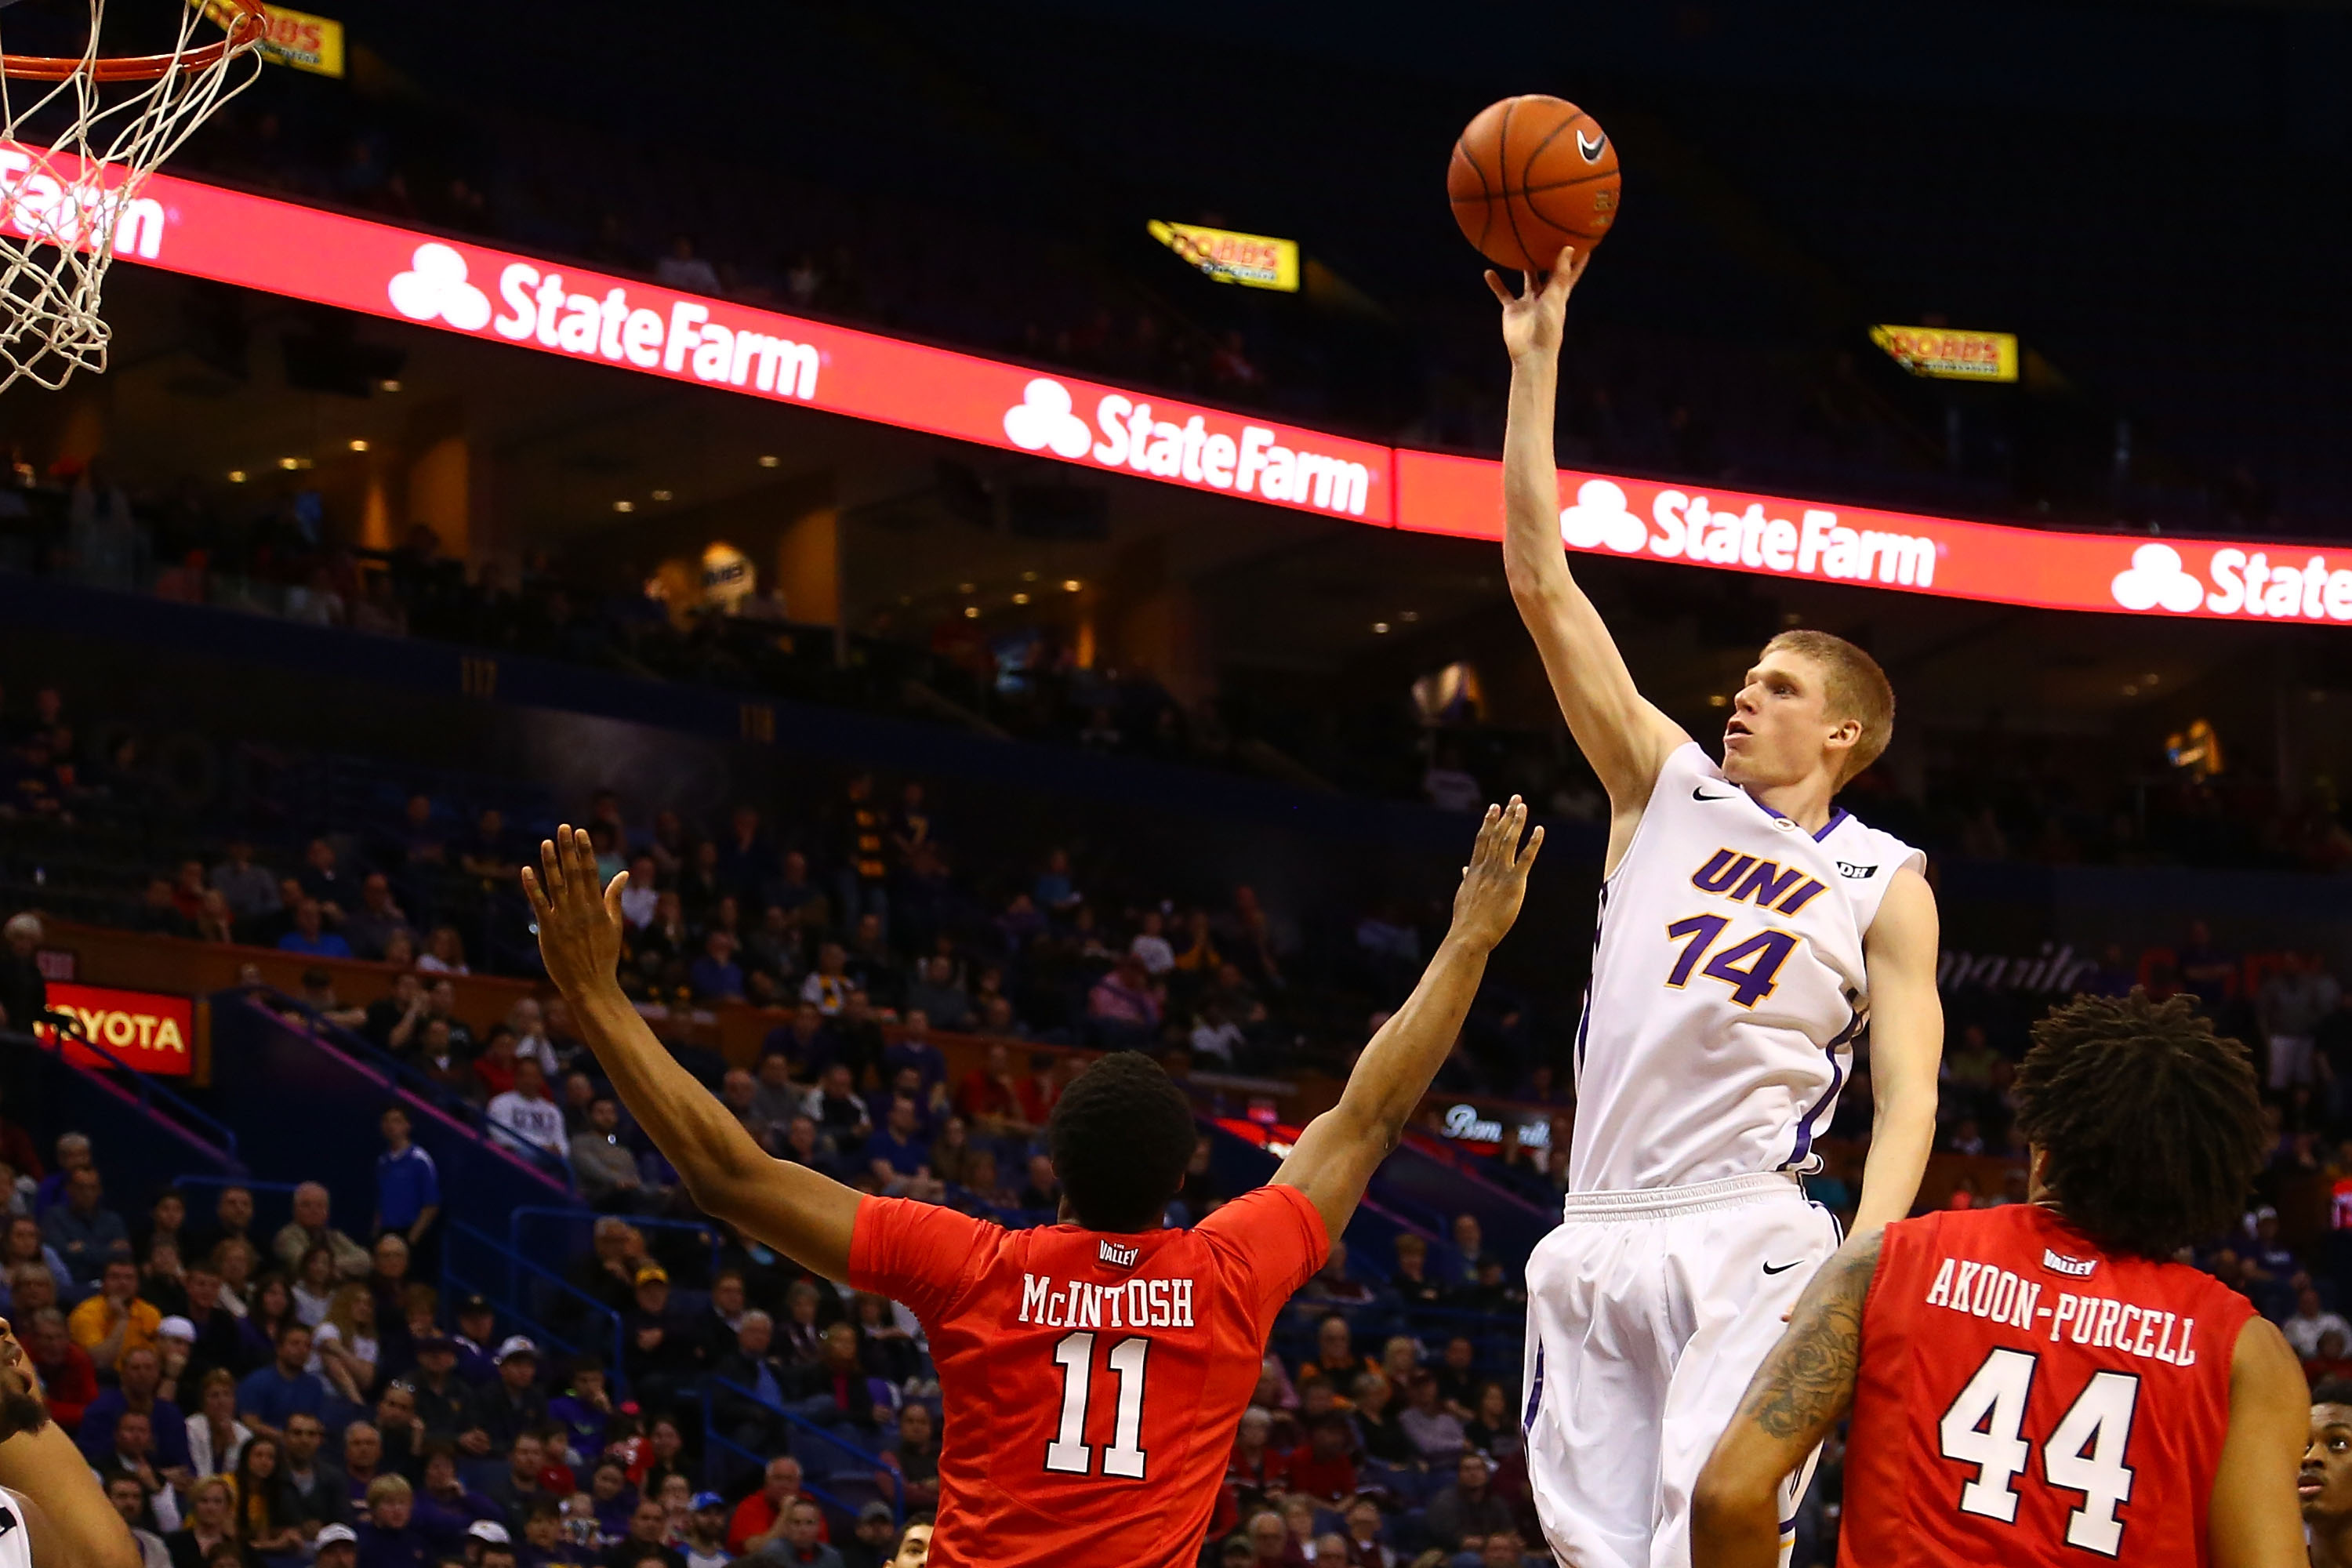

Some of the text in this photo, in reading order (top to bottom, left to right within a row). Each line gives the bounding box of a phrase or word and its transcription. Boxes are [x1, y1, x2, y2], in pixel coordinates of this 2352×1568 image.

[494, 262, 820, 400] StateFarm
[1093, 394, 1368, 516] StateFarm
[1649, 489, 1936, 588] StateFarm
[1690, 846, 1831, 918] UNI
[1664, 911, 1803, 1011] 14
[1018, 1273, 1195, 1327] McINTOSH
[1099, 1240, 1139, 1266] VALLEY
[2043, 1248, 2097, 1276] VALLEY
[1926, 1258, 2196, 1367] AKOON-PURCELL
[1044, 1329, 1152, 1480] 11
[1932, 1345, 2143, 1560] 44
